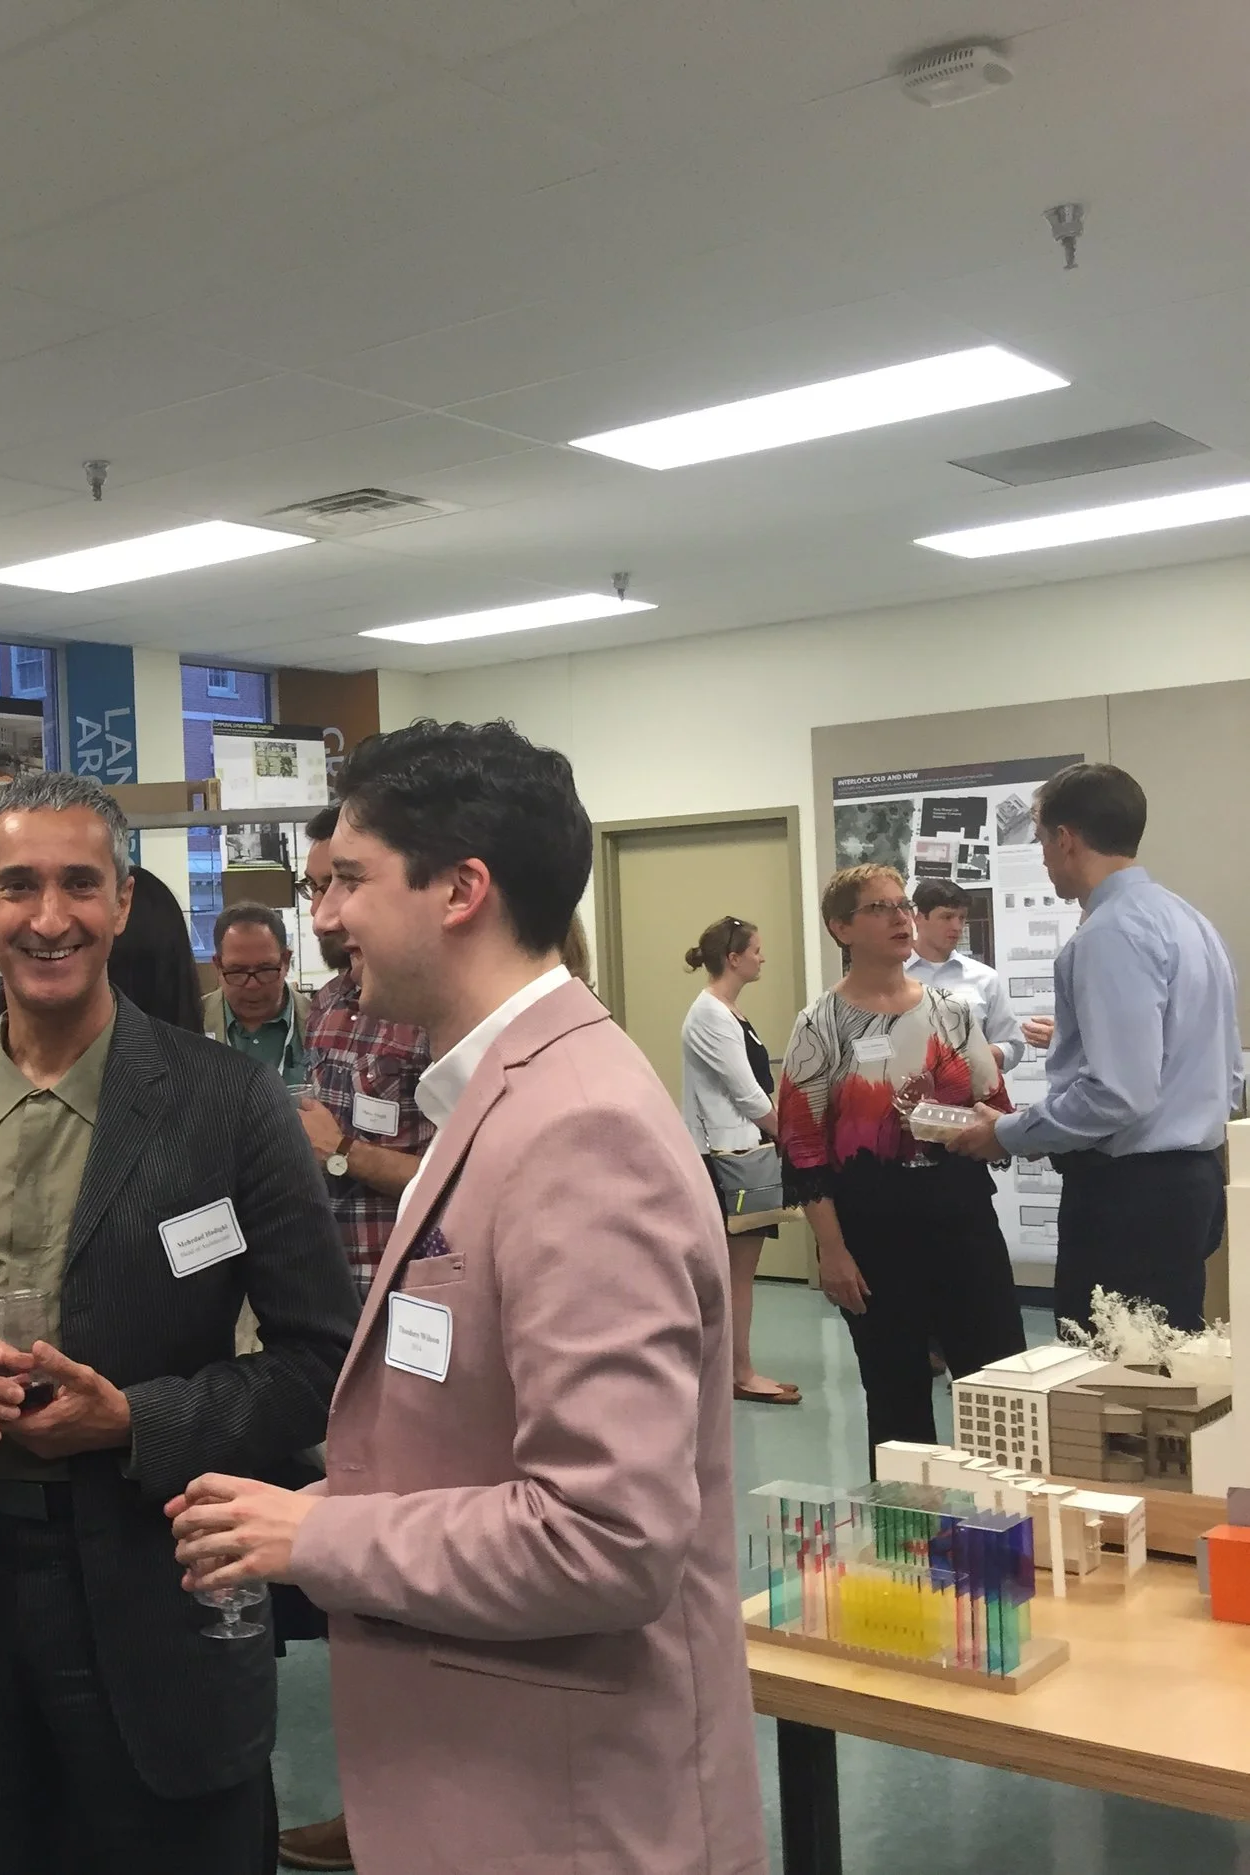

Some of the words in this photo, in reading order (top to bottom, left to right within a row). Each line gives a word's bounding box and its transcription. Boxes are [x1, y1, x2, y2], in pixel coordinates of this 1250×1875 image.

[837, 777, 871, 786] INTERLOCK
[872, 775, 886, 783] OLD
[887, 773, 902, 781] AND
[903, 772, 919, 780] NEW
